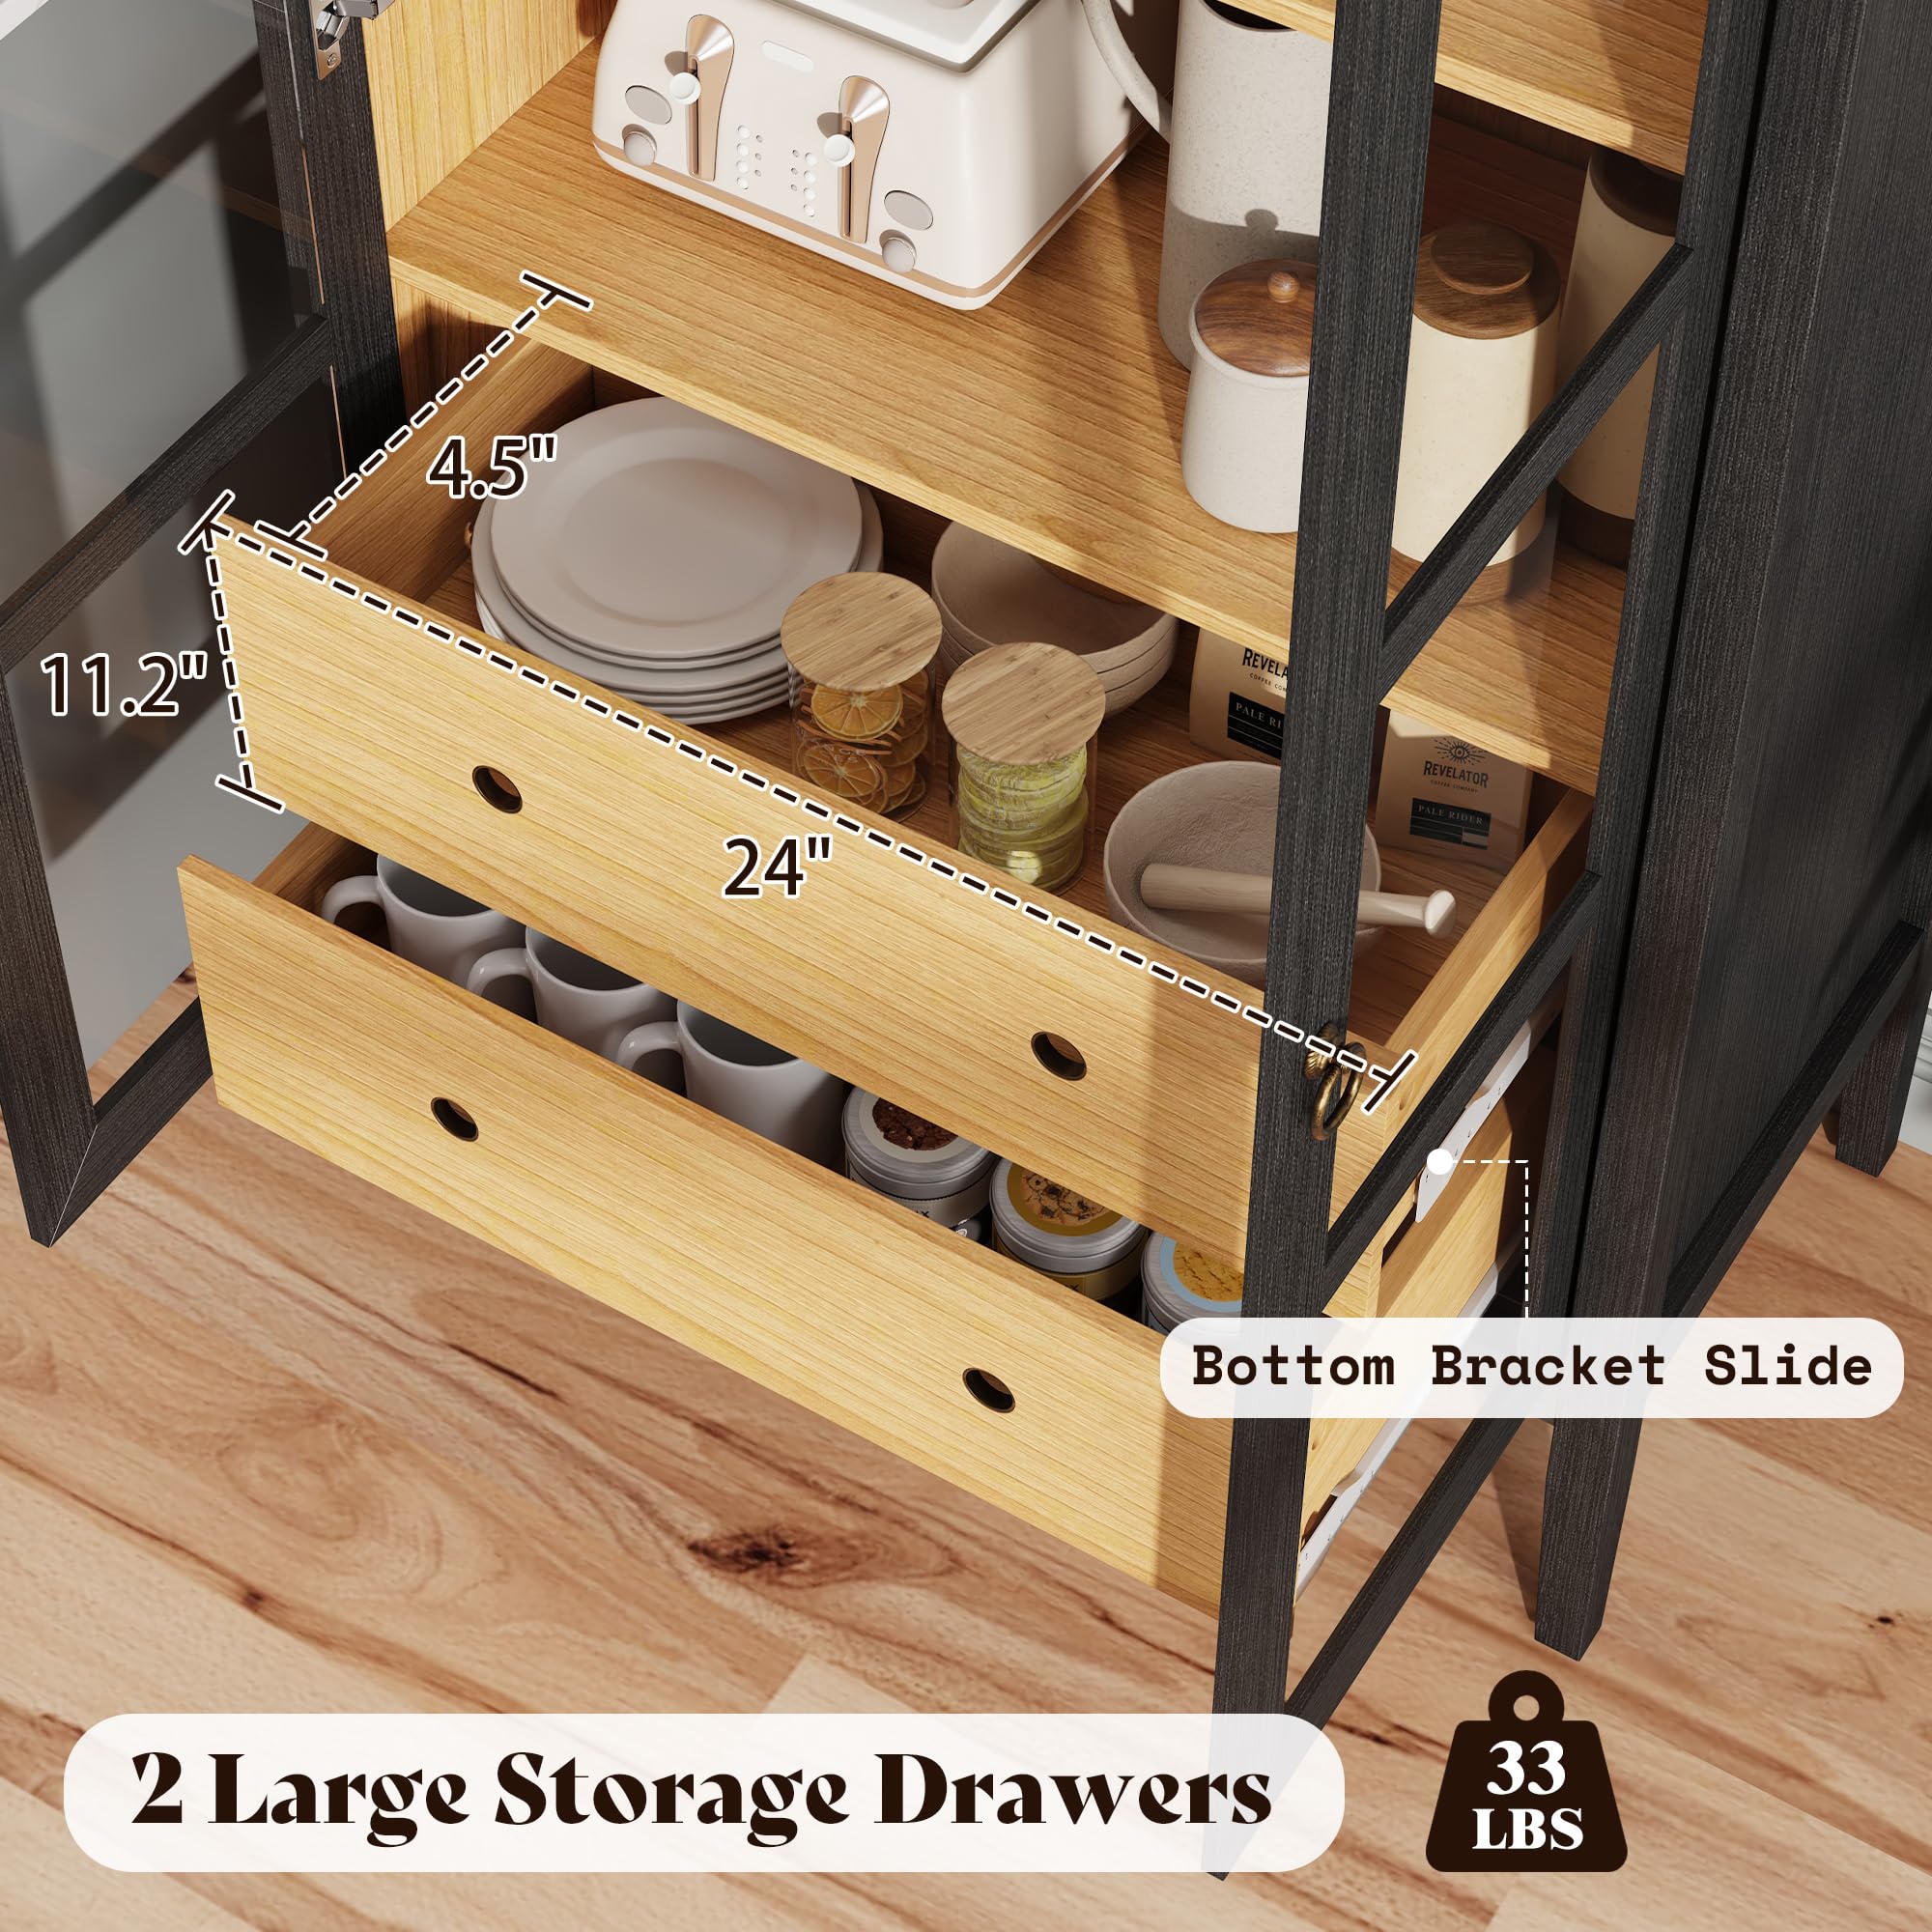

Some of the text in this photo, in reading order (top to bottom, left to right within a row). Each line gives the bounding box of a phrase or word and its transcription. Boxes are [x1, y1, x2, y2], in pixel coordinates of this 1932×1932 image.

[1242, 647, 1289, 680] REVELA
[1236, 701, 1264, 722] PALE
[1423, 760, 1489, 788] REVELATOR
[1417, 804, 1483, 826] PALE RIDER
